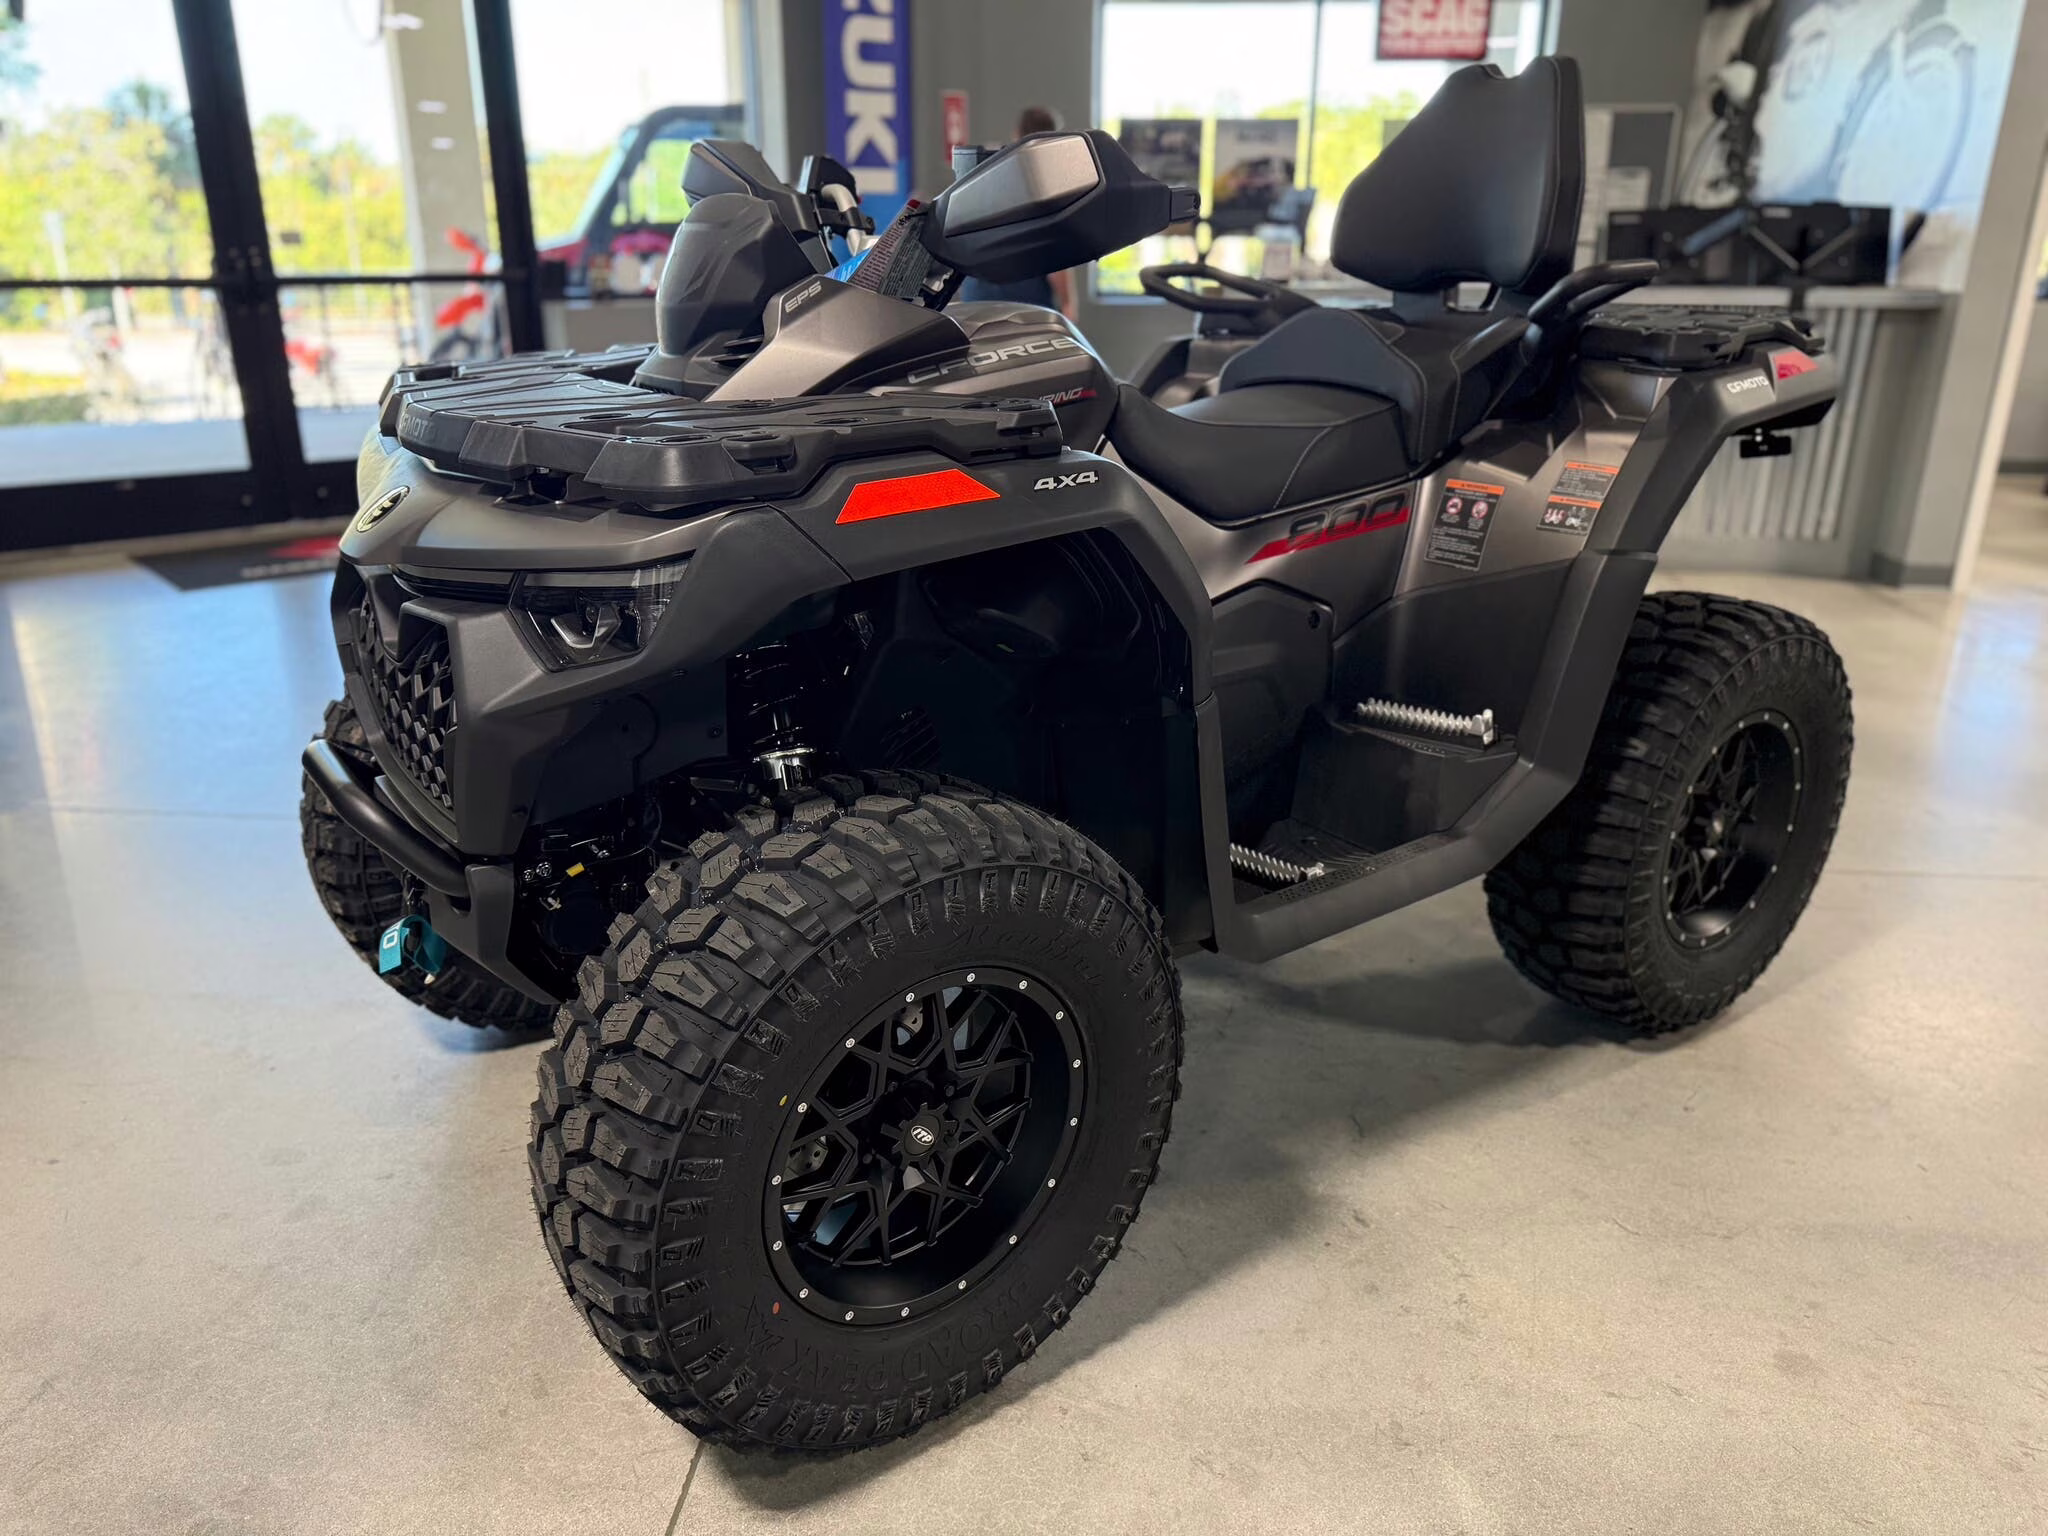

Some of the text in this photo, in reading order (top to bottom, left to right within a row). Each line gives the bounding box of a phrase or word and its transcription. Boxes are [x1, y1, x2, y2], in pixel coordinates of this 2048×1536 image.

[841, 0, 898, 195] UKI
[784, 281, 823, 314] EPS
[907, 338, 1077, 384] CFORCE
[1726, 375, 1769, 394] CFMOTO
[913, 1128, 933, 1142] ITP
